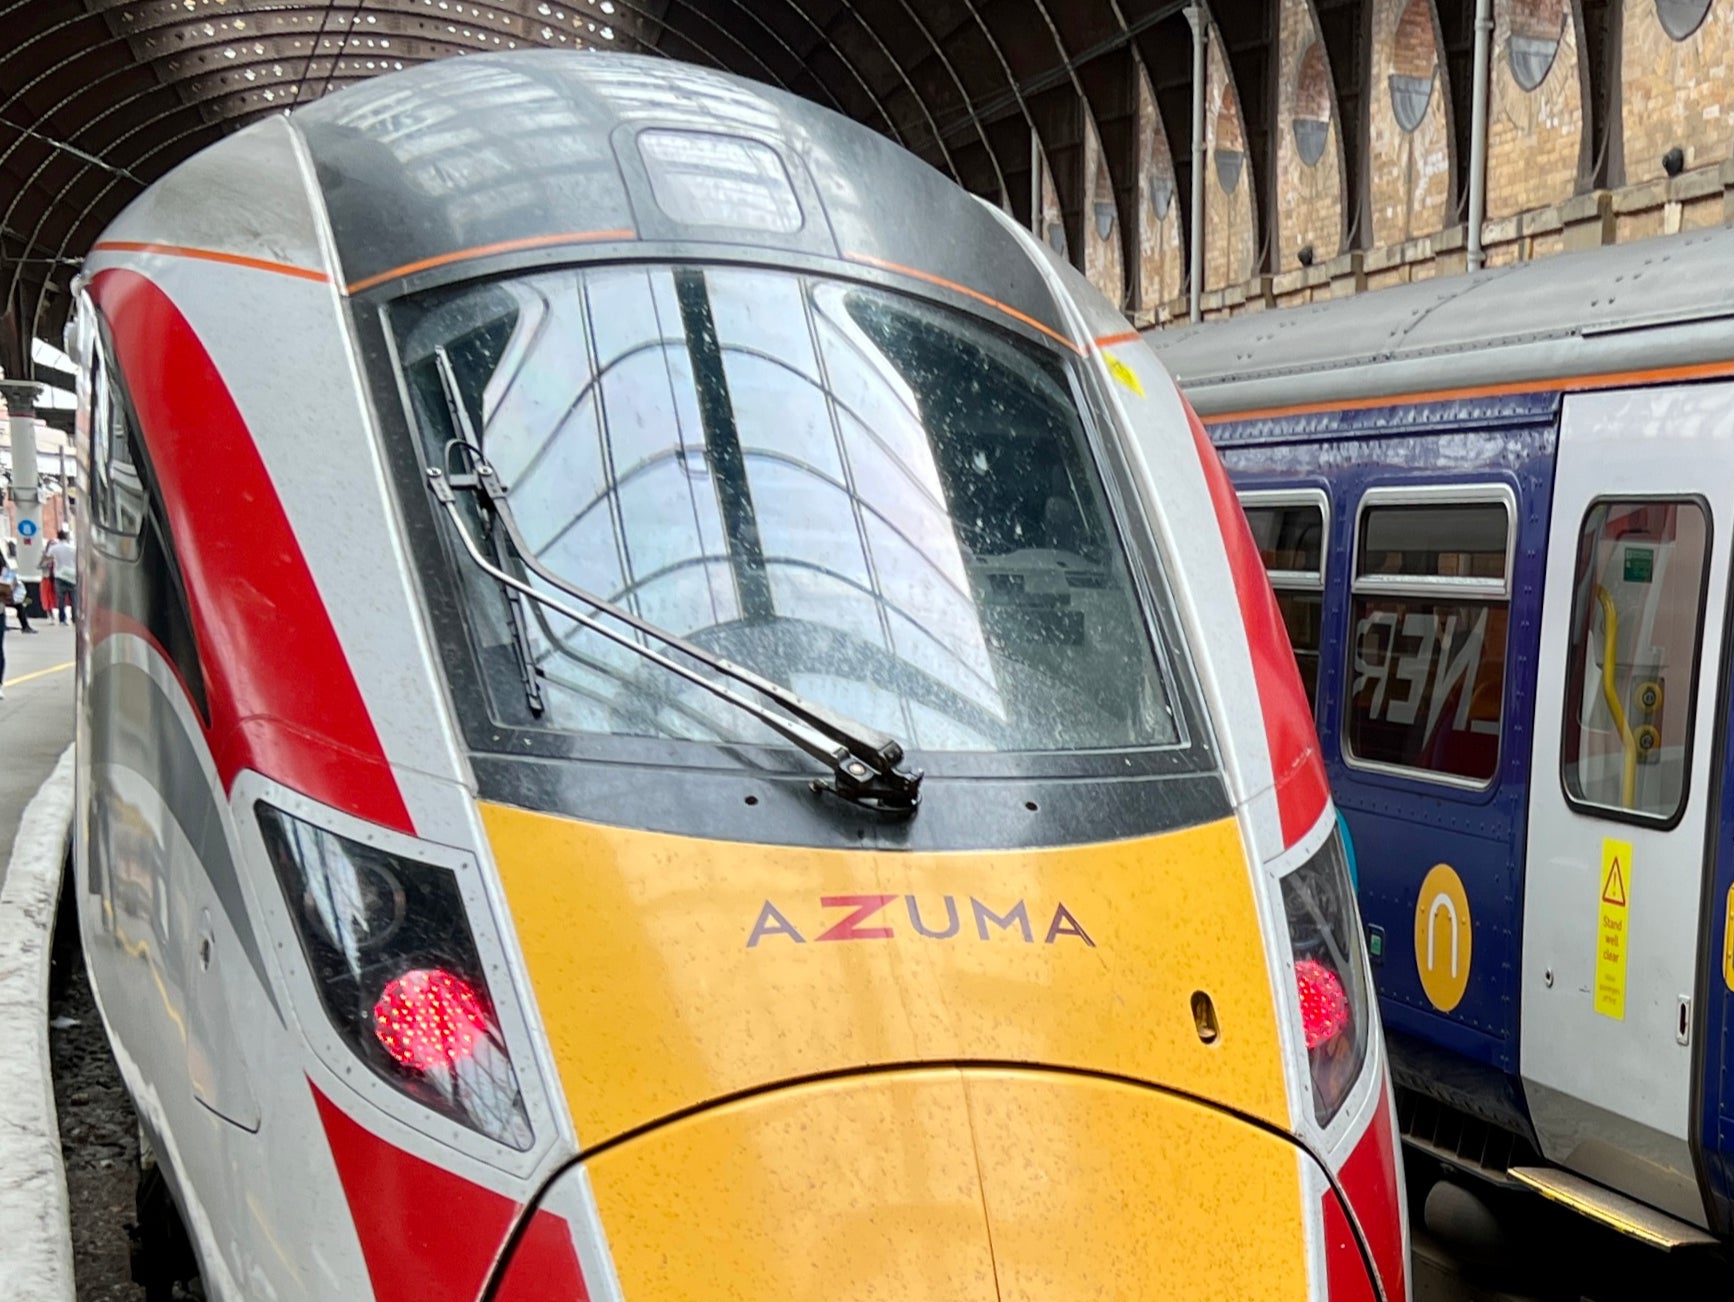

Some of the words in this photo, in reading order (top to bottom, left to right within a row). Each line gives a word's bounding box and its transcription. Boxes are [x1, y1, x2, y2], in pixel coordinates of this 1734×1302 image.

[746, 894, 1097, 949] AZUMA
[1602, 915, 1623, 932] Stand
[1605, 934, 1619, 947] well
[1602, 948, 1620, 963] clear
